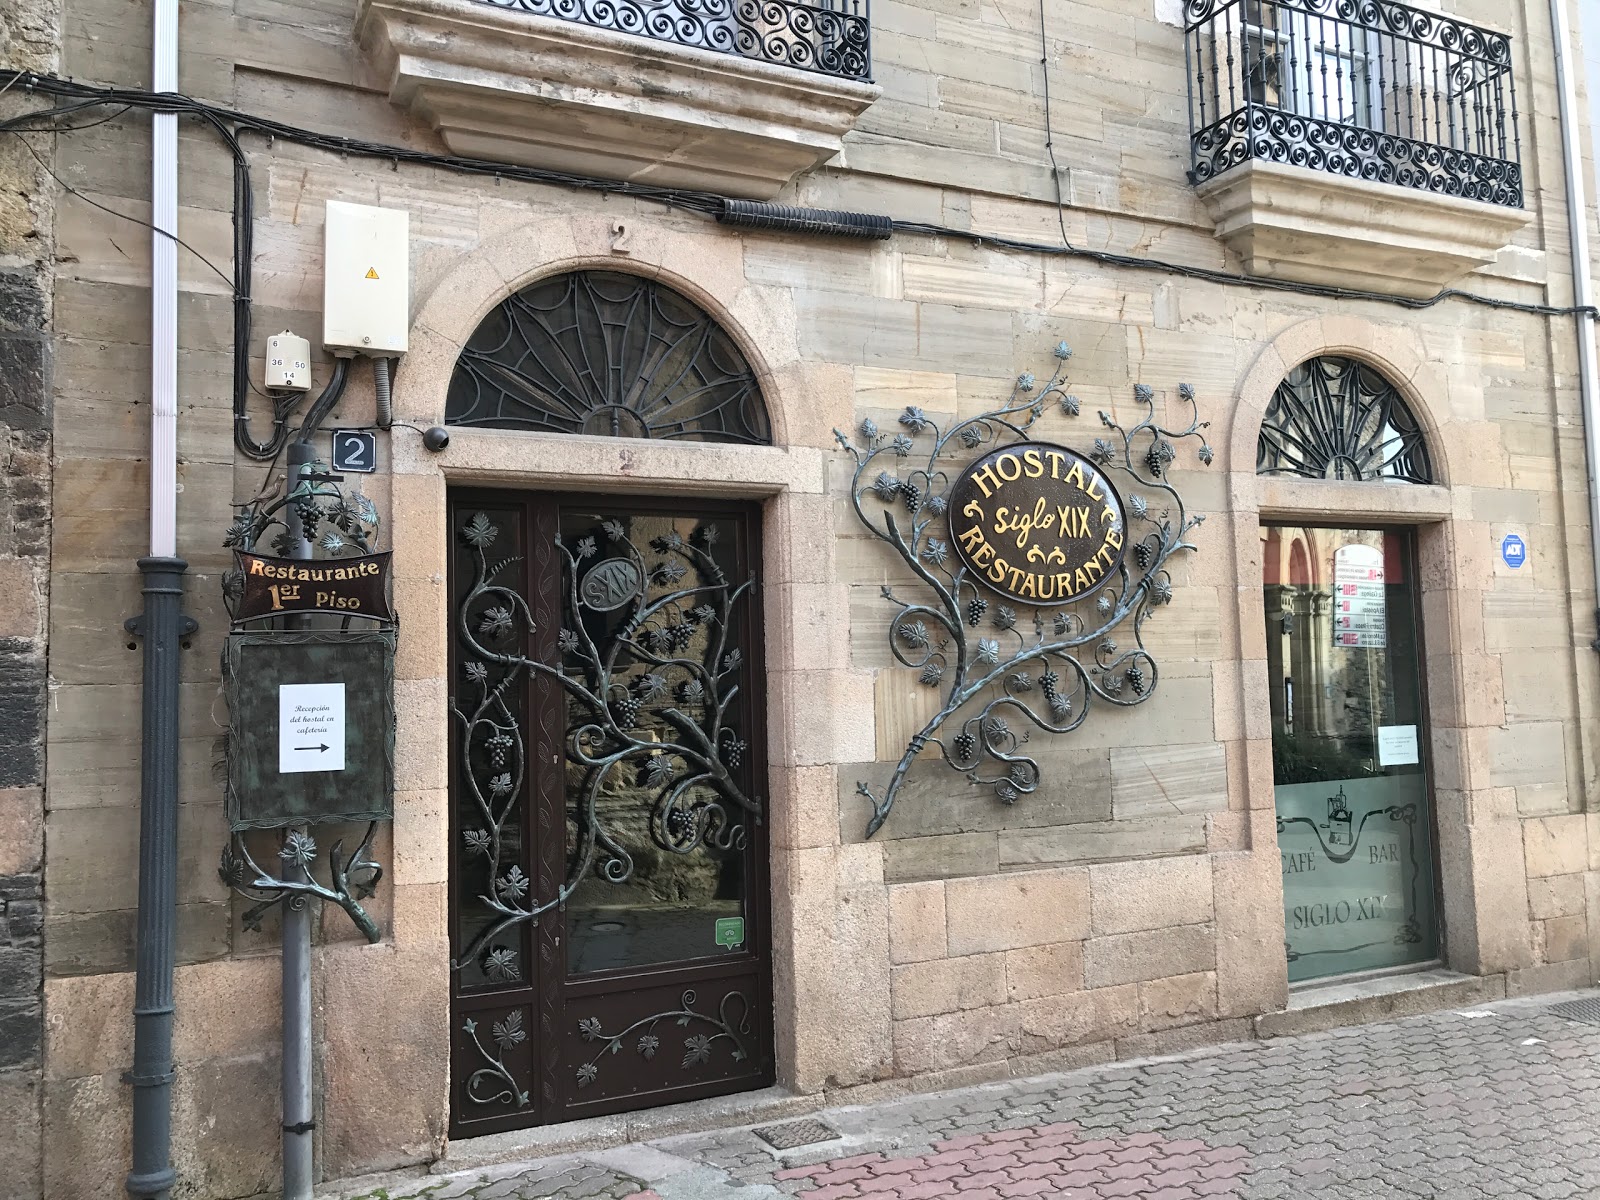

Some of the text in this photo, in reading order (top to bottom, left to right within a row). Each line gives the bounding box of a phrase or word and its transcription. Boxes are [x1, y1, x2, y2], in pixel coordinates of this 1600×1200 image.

[294, 361, 306, 369] 50
[344, 437, 365, 466] 2
[970, 449, 1104, 501] HOSTAL
[994, 496, 1092, 549] Siglo XIX
[250, 559, 380, 582] Restaurante
[958, 524, 1124, 599] RESTAURANTE
[267, 583, 361, 611] 1er Piso
[289, 715, 301, 723] del
[302, 715, 325, 723] hostal
[294, 704, 330, 714] Recepción
[296, 726, 328, 736] cafetería
[1368, 843, 1400, 865] BAR
[1293, 900, 1351, 930] SIGLO
